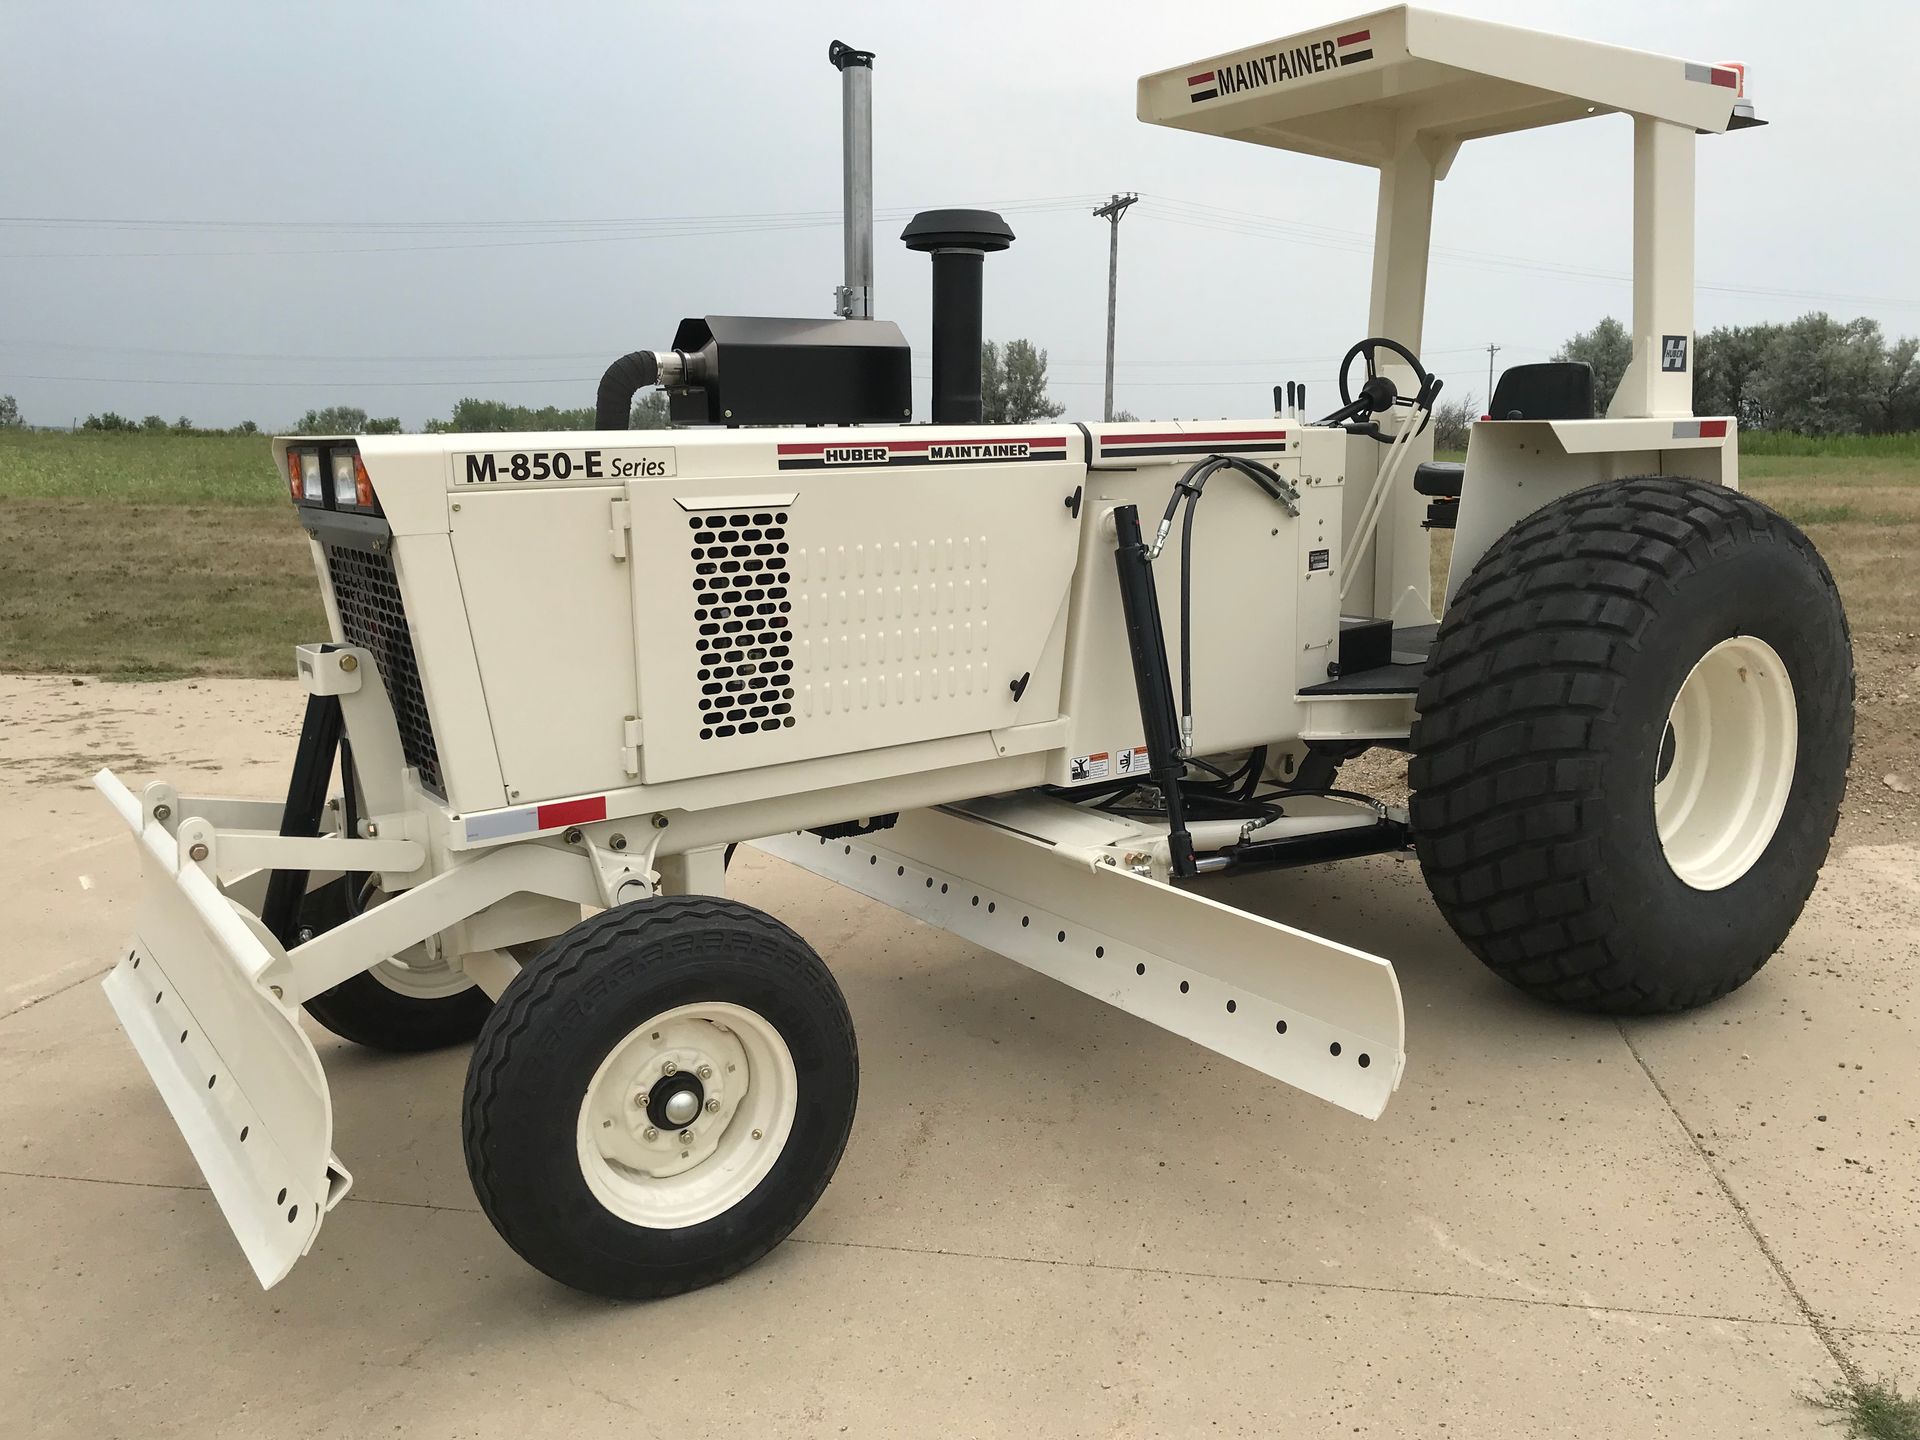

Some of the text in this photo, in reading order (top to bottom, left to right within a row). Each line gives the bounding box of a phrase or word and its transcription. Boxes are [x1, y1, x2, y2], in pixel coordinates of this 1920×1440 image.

[1217, 40, 1339, 96] MAINTAINER
[466, 451, 665, 483] M-850-E Series
[825, 444, 1029, 462] HUBER MAINTAINER
